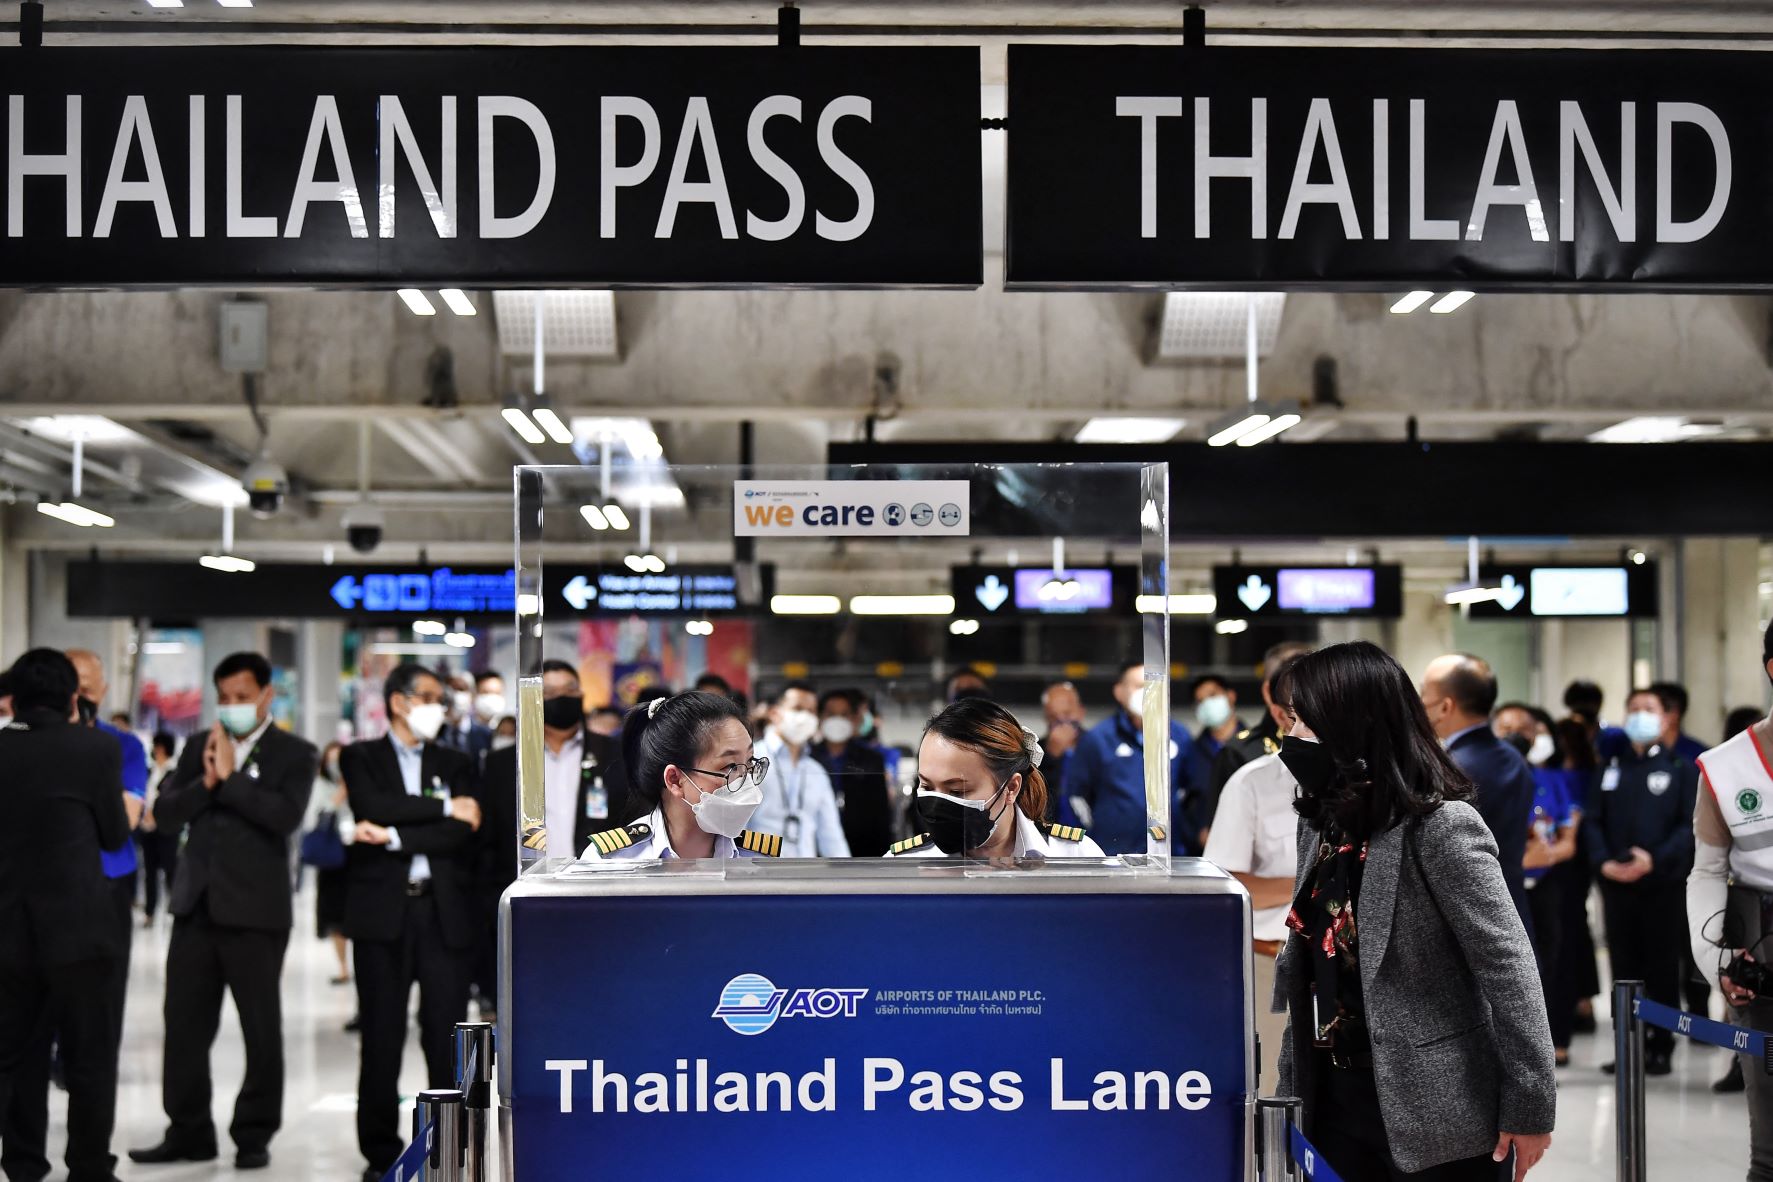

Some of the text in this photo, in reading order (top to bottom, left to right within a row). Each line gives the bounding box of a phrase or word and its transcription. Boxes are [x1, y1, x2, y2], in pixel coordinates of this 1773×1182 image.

[8, 94, 875, 242] HAILAND PASS
[1115, 96, 1732, 243] THAILAND
[744, 505, 875, 527] we care
[780, 987, 869, 1018] AOT
[875, 990, 1046, 1001] AIRPORTS OF THAILAND PLC.
[1678, 1015, 1691, 1032] AOT
[1734, 1031, 1748, 1048] AOT
[545, 1057, 1212, 1113] Thailand Pass Lane
